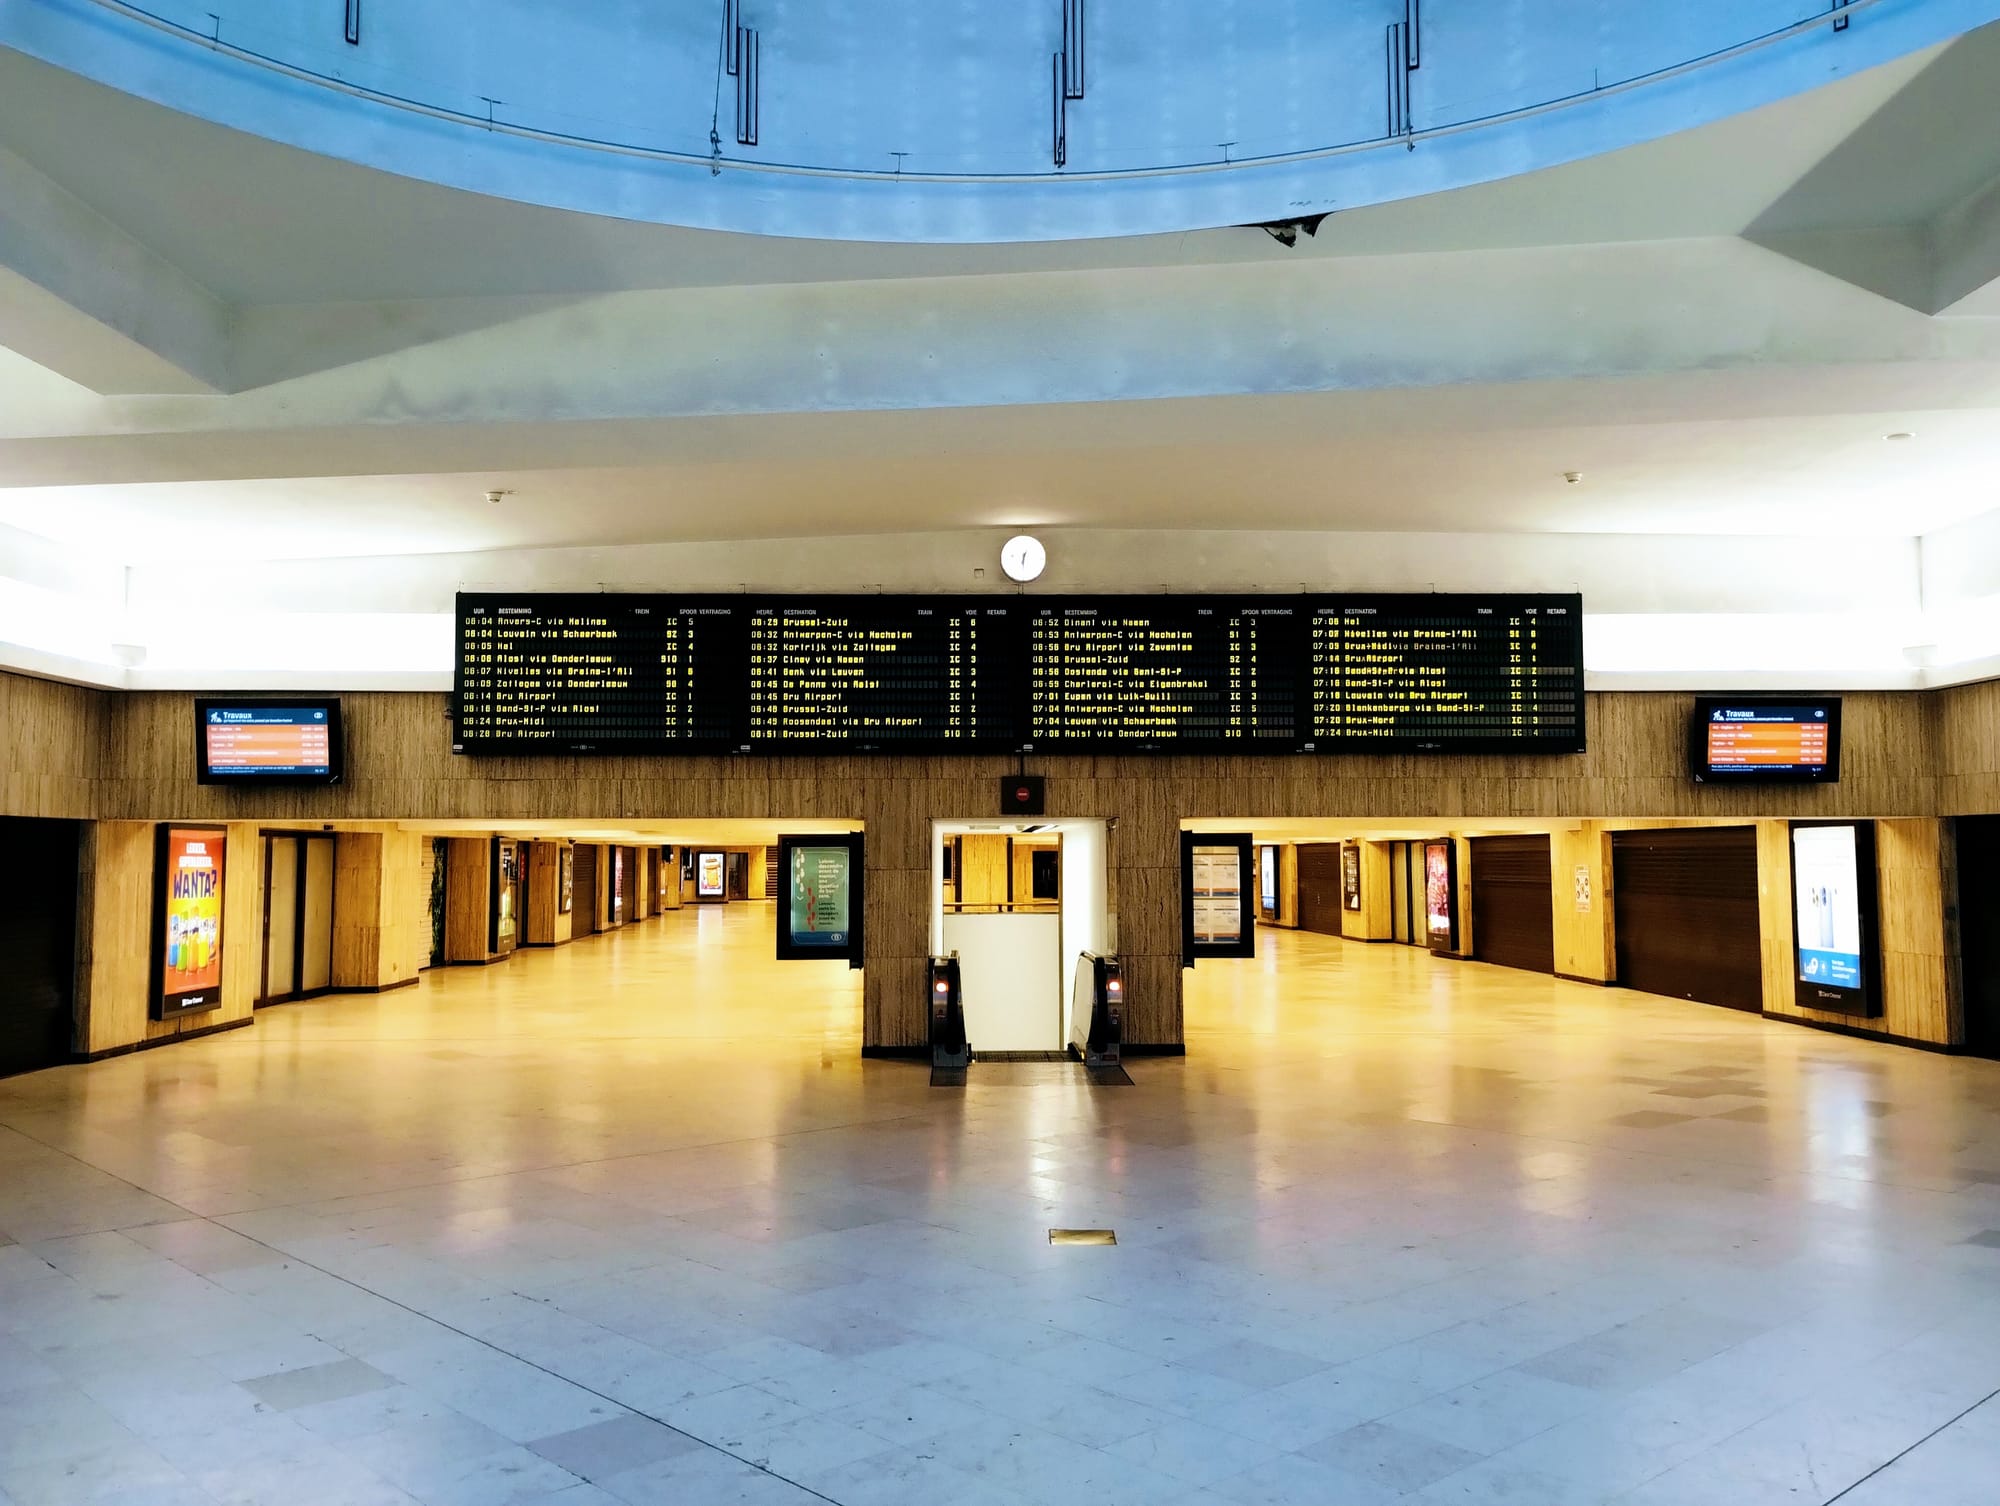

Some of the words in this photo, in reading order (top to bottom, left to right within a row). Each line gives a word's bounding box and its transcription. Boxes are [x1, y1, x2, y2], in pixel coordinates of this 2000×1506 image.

[547, 617, 564, 626] via
[666, 617, 678, 626] IC
[1101, 619, 1118, 627] via
[541, 629, 558, 638] via
[847, 631, 864, 639] via
[1128, 631, 1145, 639] via
[1392, 629, 1409, 638] via
[666, 642, 678, 651] IC
[831, 643, 848, 652] via
[1128, 643, 1145, 652] via
[529, 654, 547, 663] via
[815, 655, 832, 664] via
[546, 667, 563, 676] via
[810, 667, 827, 677] via
[1112, 667, 1129, 676] via
[545, 679, 563, 688] via
[831, 680, 848, 689] via
[1128, 680, 1145, 689] via
[1398, 679, 1415, 687] via
[1096, 692, 1113, 701] via
[1388, 691, 1405, 700] via
[551, 704, 568, 713] via
[1128, 705, 1145, 713] via
[1414, 703, 1432, 712] via
[223, 711, 253, 719] Travaux
[1725, 709, 1754, 717] Travaux
[842, 717, 859, 726] via
[1101, 717, 1119, 726] via
[1096, 729, 1114, 738] via
[173, 869, 217, 899] WANTA?
